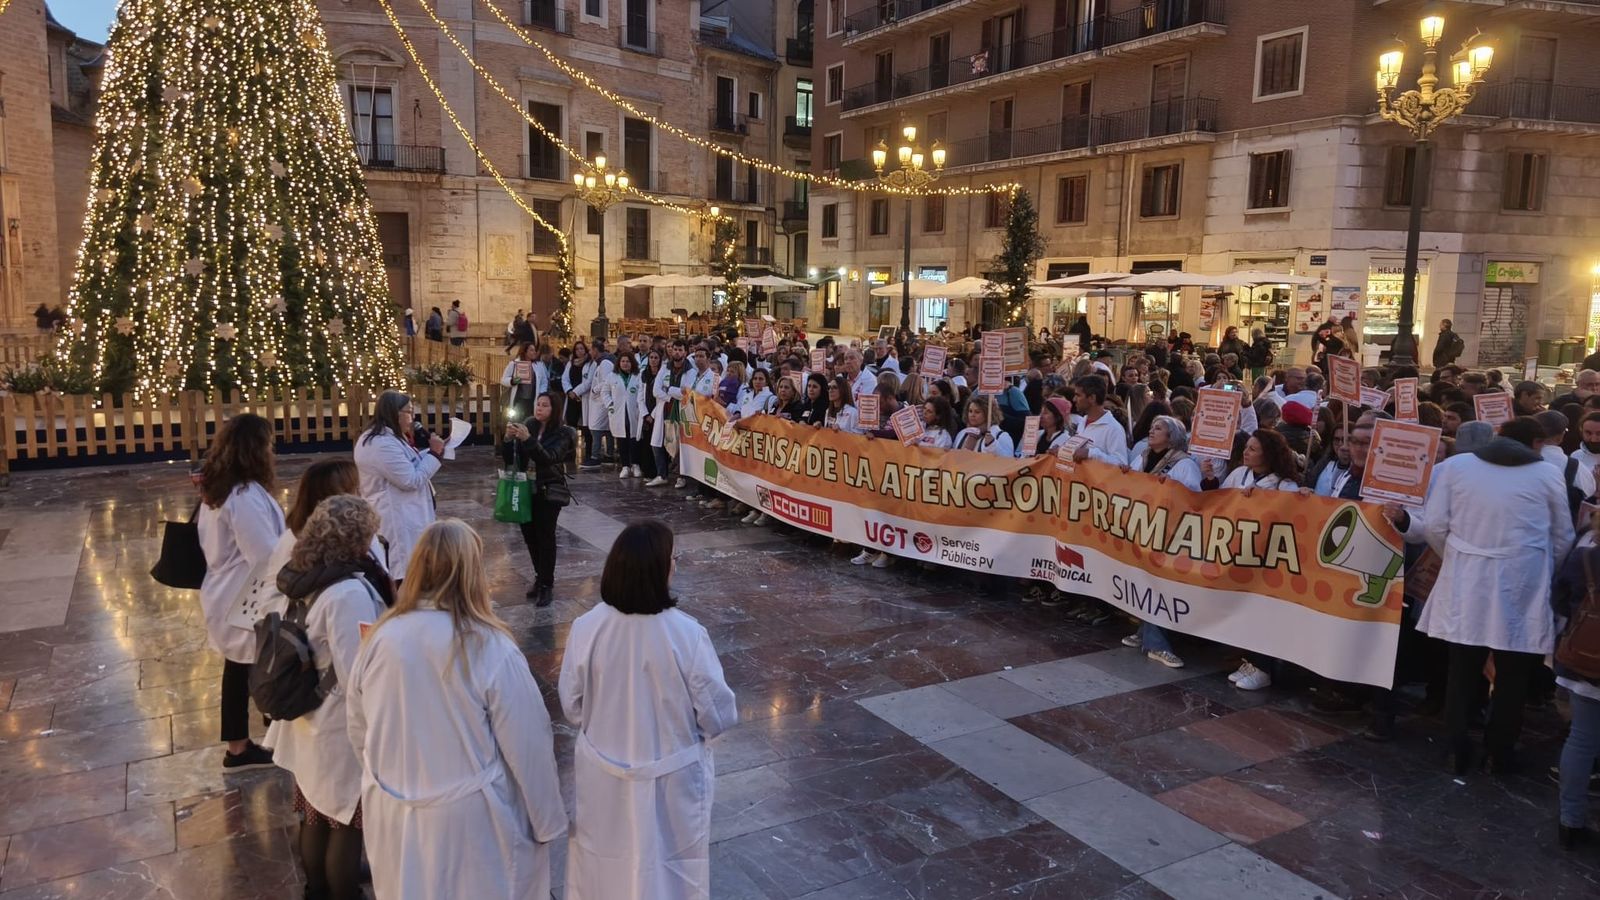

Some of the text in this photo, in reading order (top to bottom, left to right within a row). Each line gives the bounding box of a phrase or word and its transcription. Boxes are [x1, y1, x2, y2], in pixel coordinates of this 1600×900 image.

[1377, 266, 1420, 274] HELADEA
[701, 414, 1302, 575] EN DEFENSA DE LA ATENCIÓN PRIMARIA
[772, 494, 810, 522] CCOO
[864, 520, 909, 550] UGT
[940, 536, 980, 552] Serveis
[941, 549, 994, 569] Públics PV
[1029, 568, 1056, 582] SALUT
[1111, 574, 1191, 624] SIMAP
